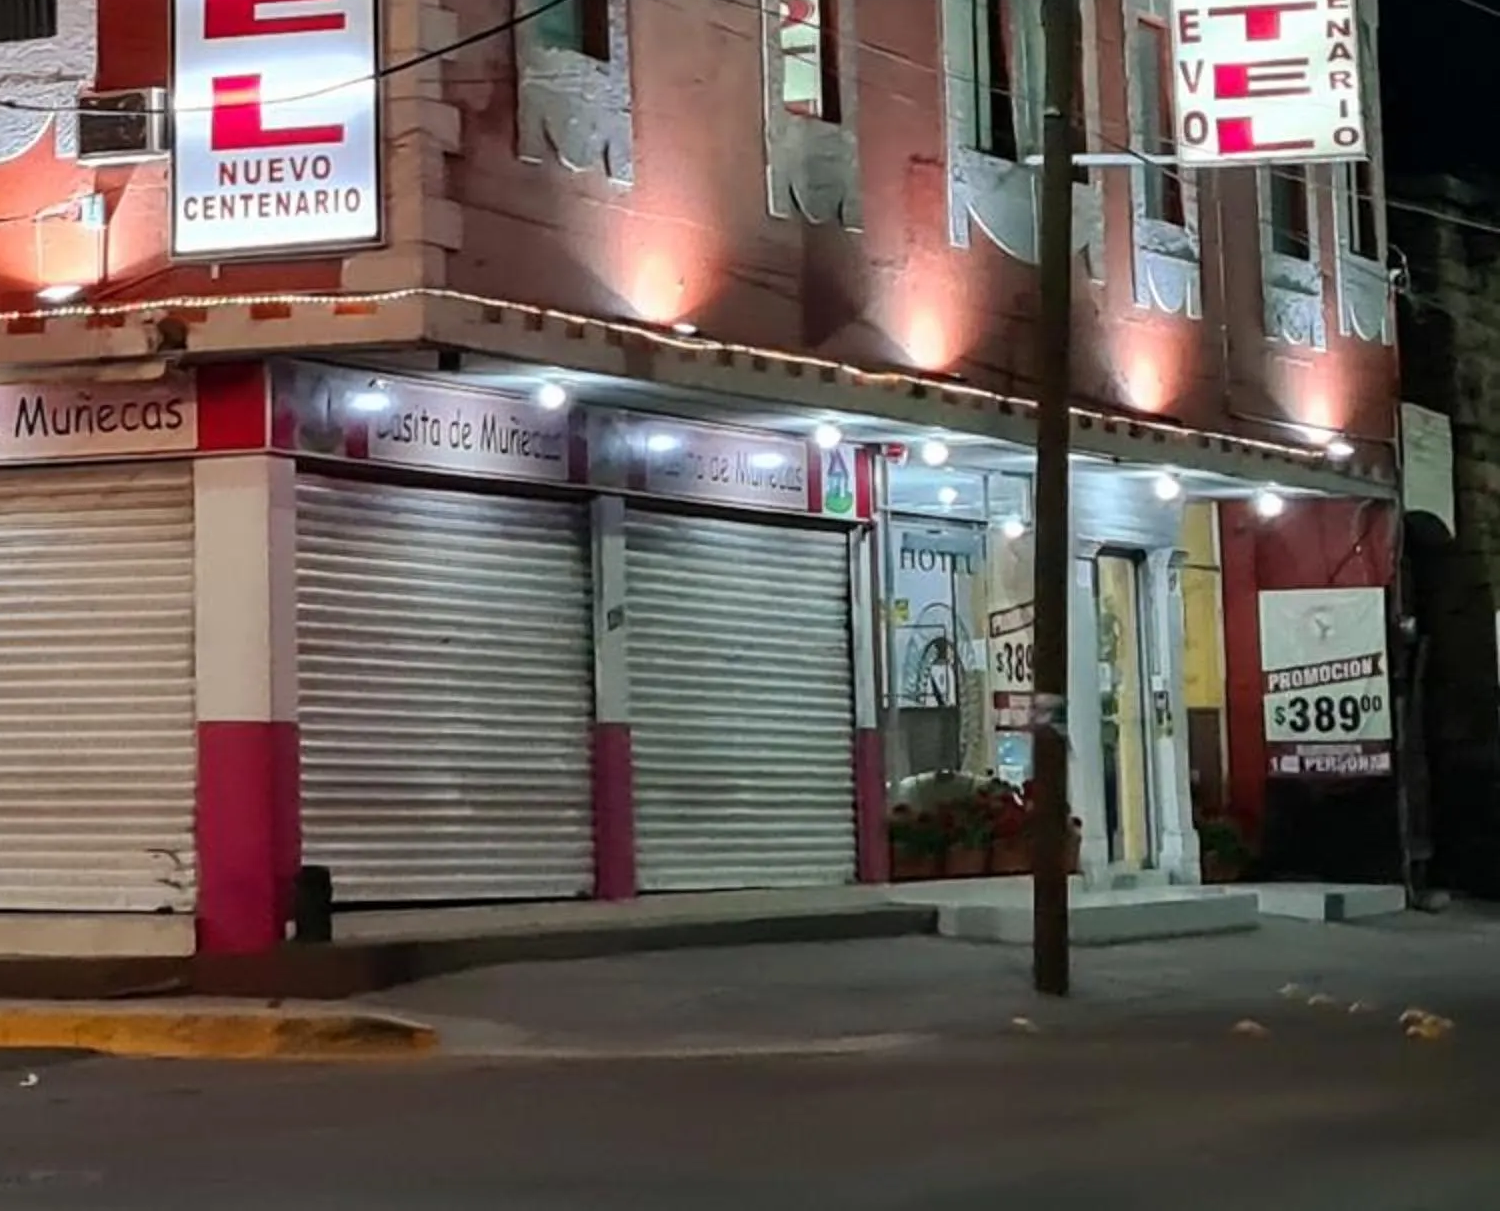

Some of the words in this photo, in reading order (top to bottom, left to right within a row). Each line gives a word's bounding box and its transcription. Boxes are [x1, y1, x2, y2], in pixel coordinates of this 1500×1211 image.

[218, 155, 332, 186] NUEVO
[183, 187, 361, 221] CENTENARIO
[14, 391, 184, 439] Muñecas
[450, 408, 473, 450] de
[1268, 656, 1374, 691] PROMOCION
